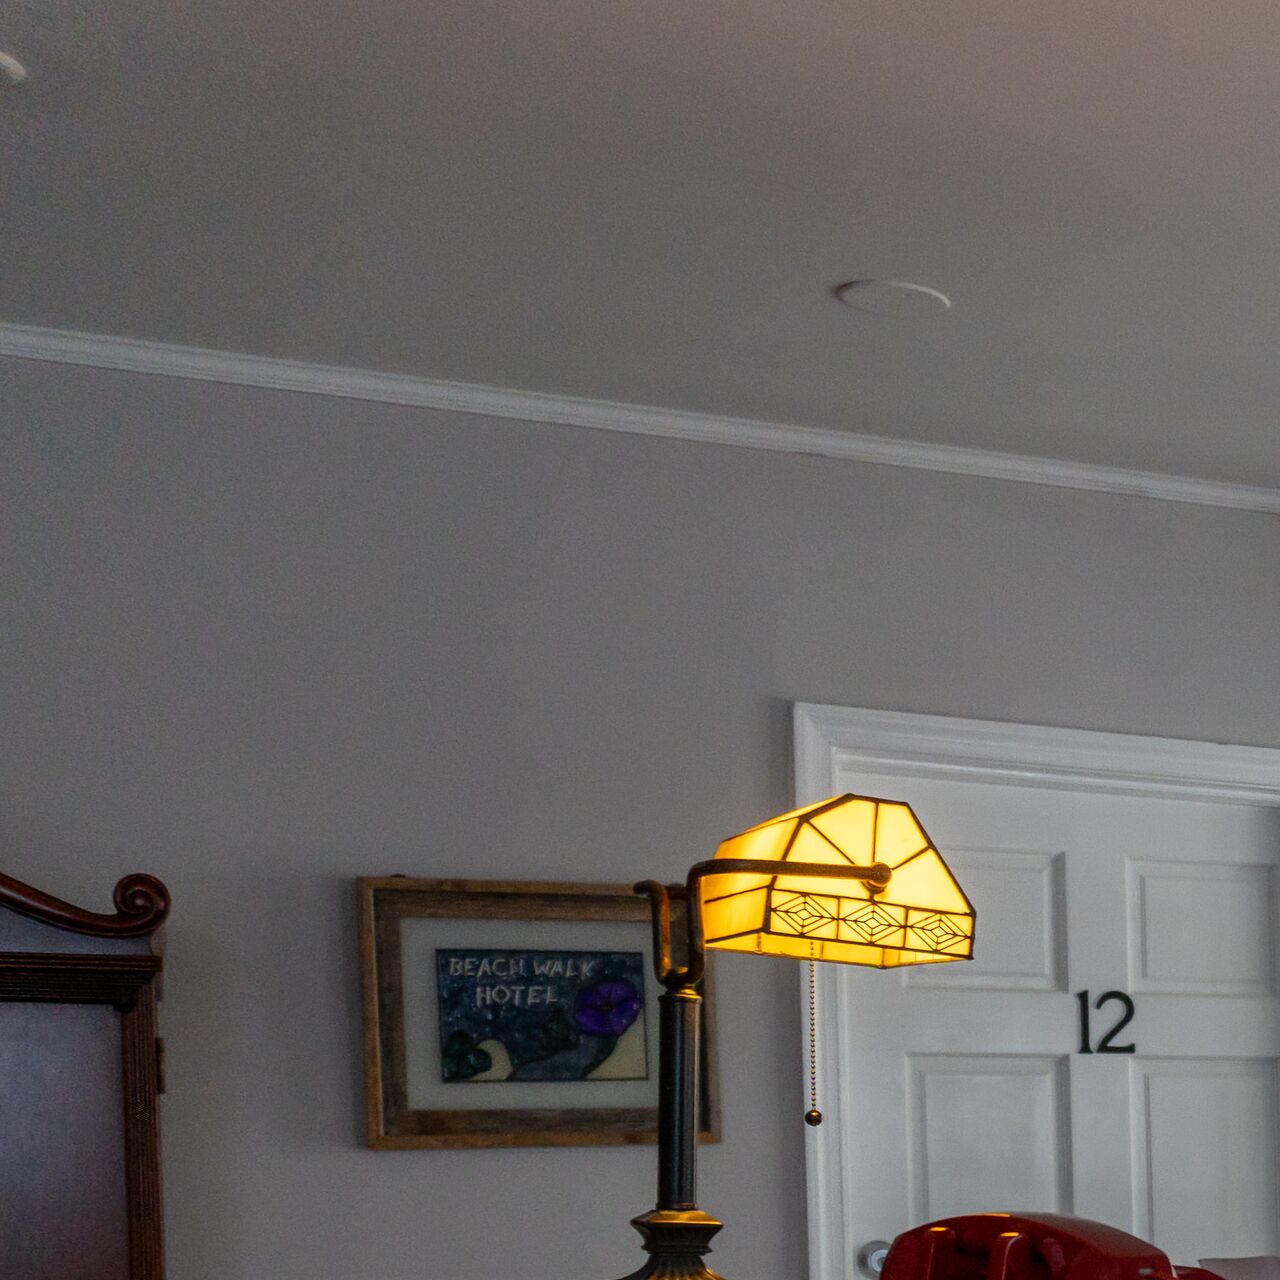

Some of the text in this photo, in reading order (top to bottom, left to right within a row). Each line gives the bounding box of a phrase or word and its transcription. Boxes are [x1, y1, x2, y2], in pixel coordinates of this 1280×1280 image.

[447, 957, 599, 979] BEACH WALK
[475, 983, 560, 1009] HOTEL
[1077, 989, 1136, 1055] 12
